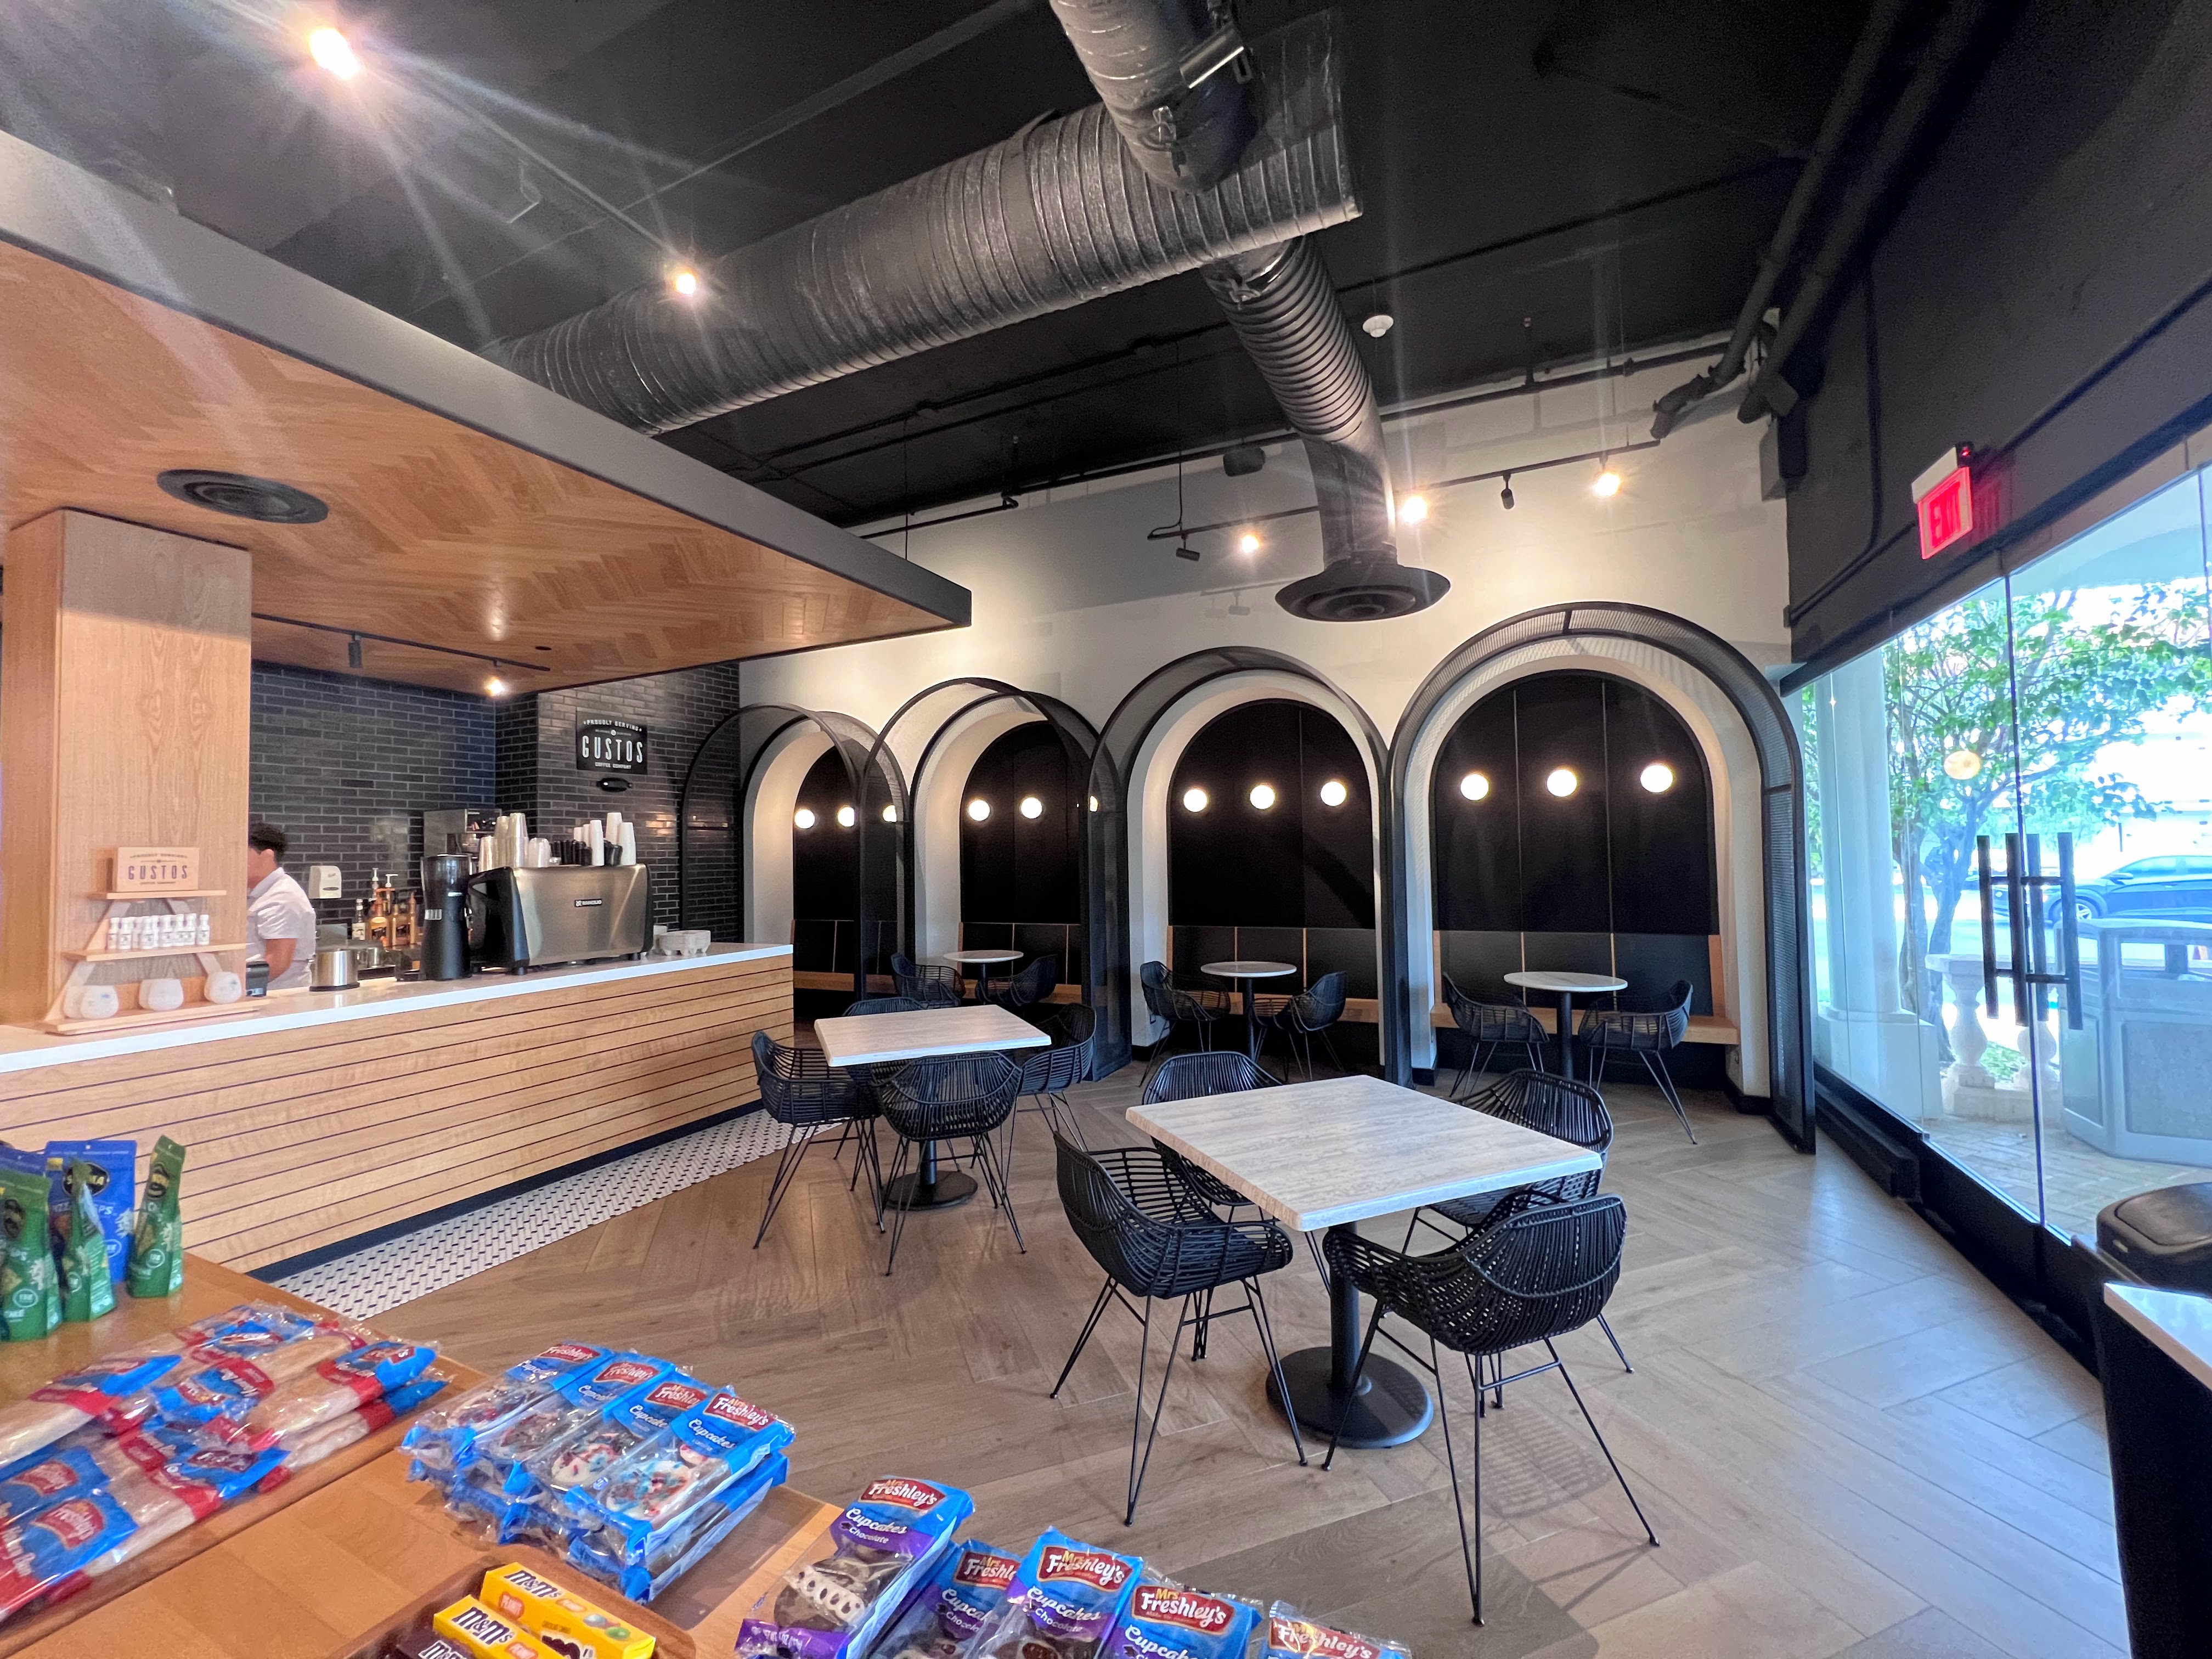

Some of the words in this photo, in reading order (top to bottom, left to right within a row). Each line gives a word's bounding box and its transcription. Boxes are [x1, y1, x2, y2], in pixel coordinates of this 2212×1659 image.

[614, 721, 639, 731] SERVING
[582, 735, 643, 763] GUSTOS
[128, 865, 188, 880] GUSTOS
[713, 1397, 769, 1426] Freshley's
[689, 1418, 736, 1449] Cupcakes
[868, 1483, 938, 1506] Freshley's
[845, 1508, 907, 1534] Cupcakes
[849, 1528, 889, 1544] Chocolate
[1046, 1554, 1125, 1585] Freshley's
[1027, 1585, 1101, 1621] Cupcakes
[1141, 1593, 1227, 1628] Freshley's
[1035, 1608, 1084, 1633] Chocolate
